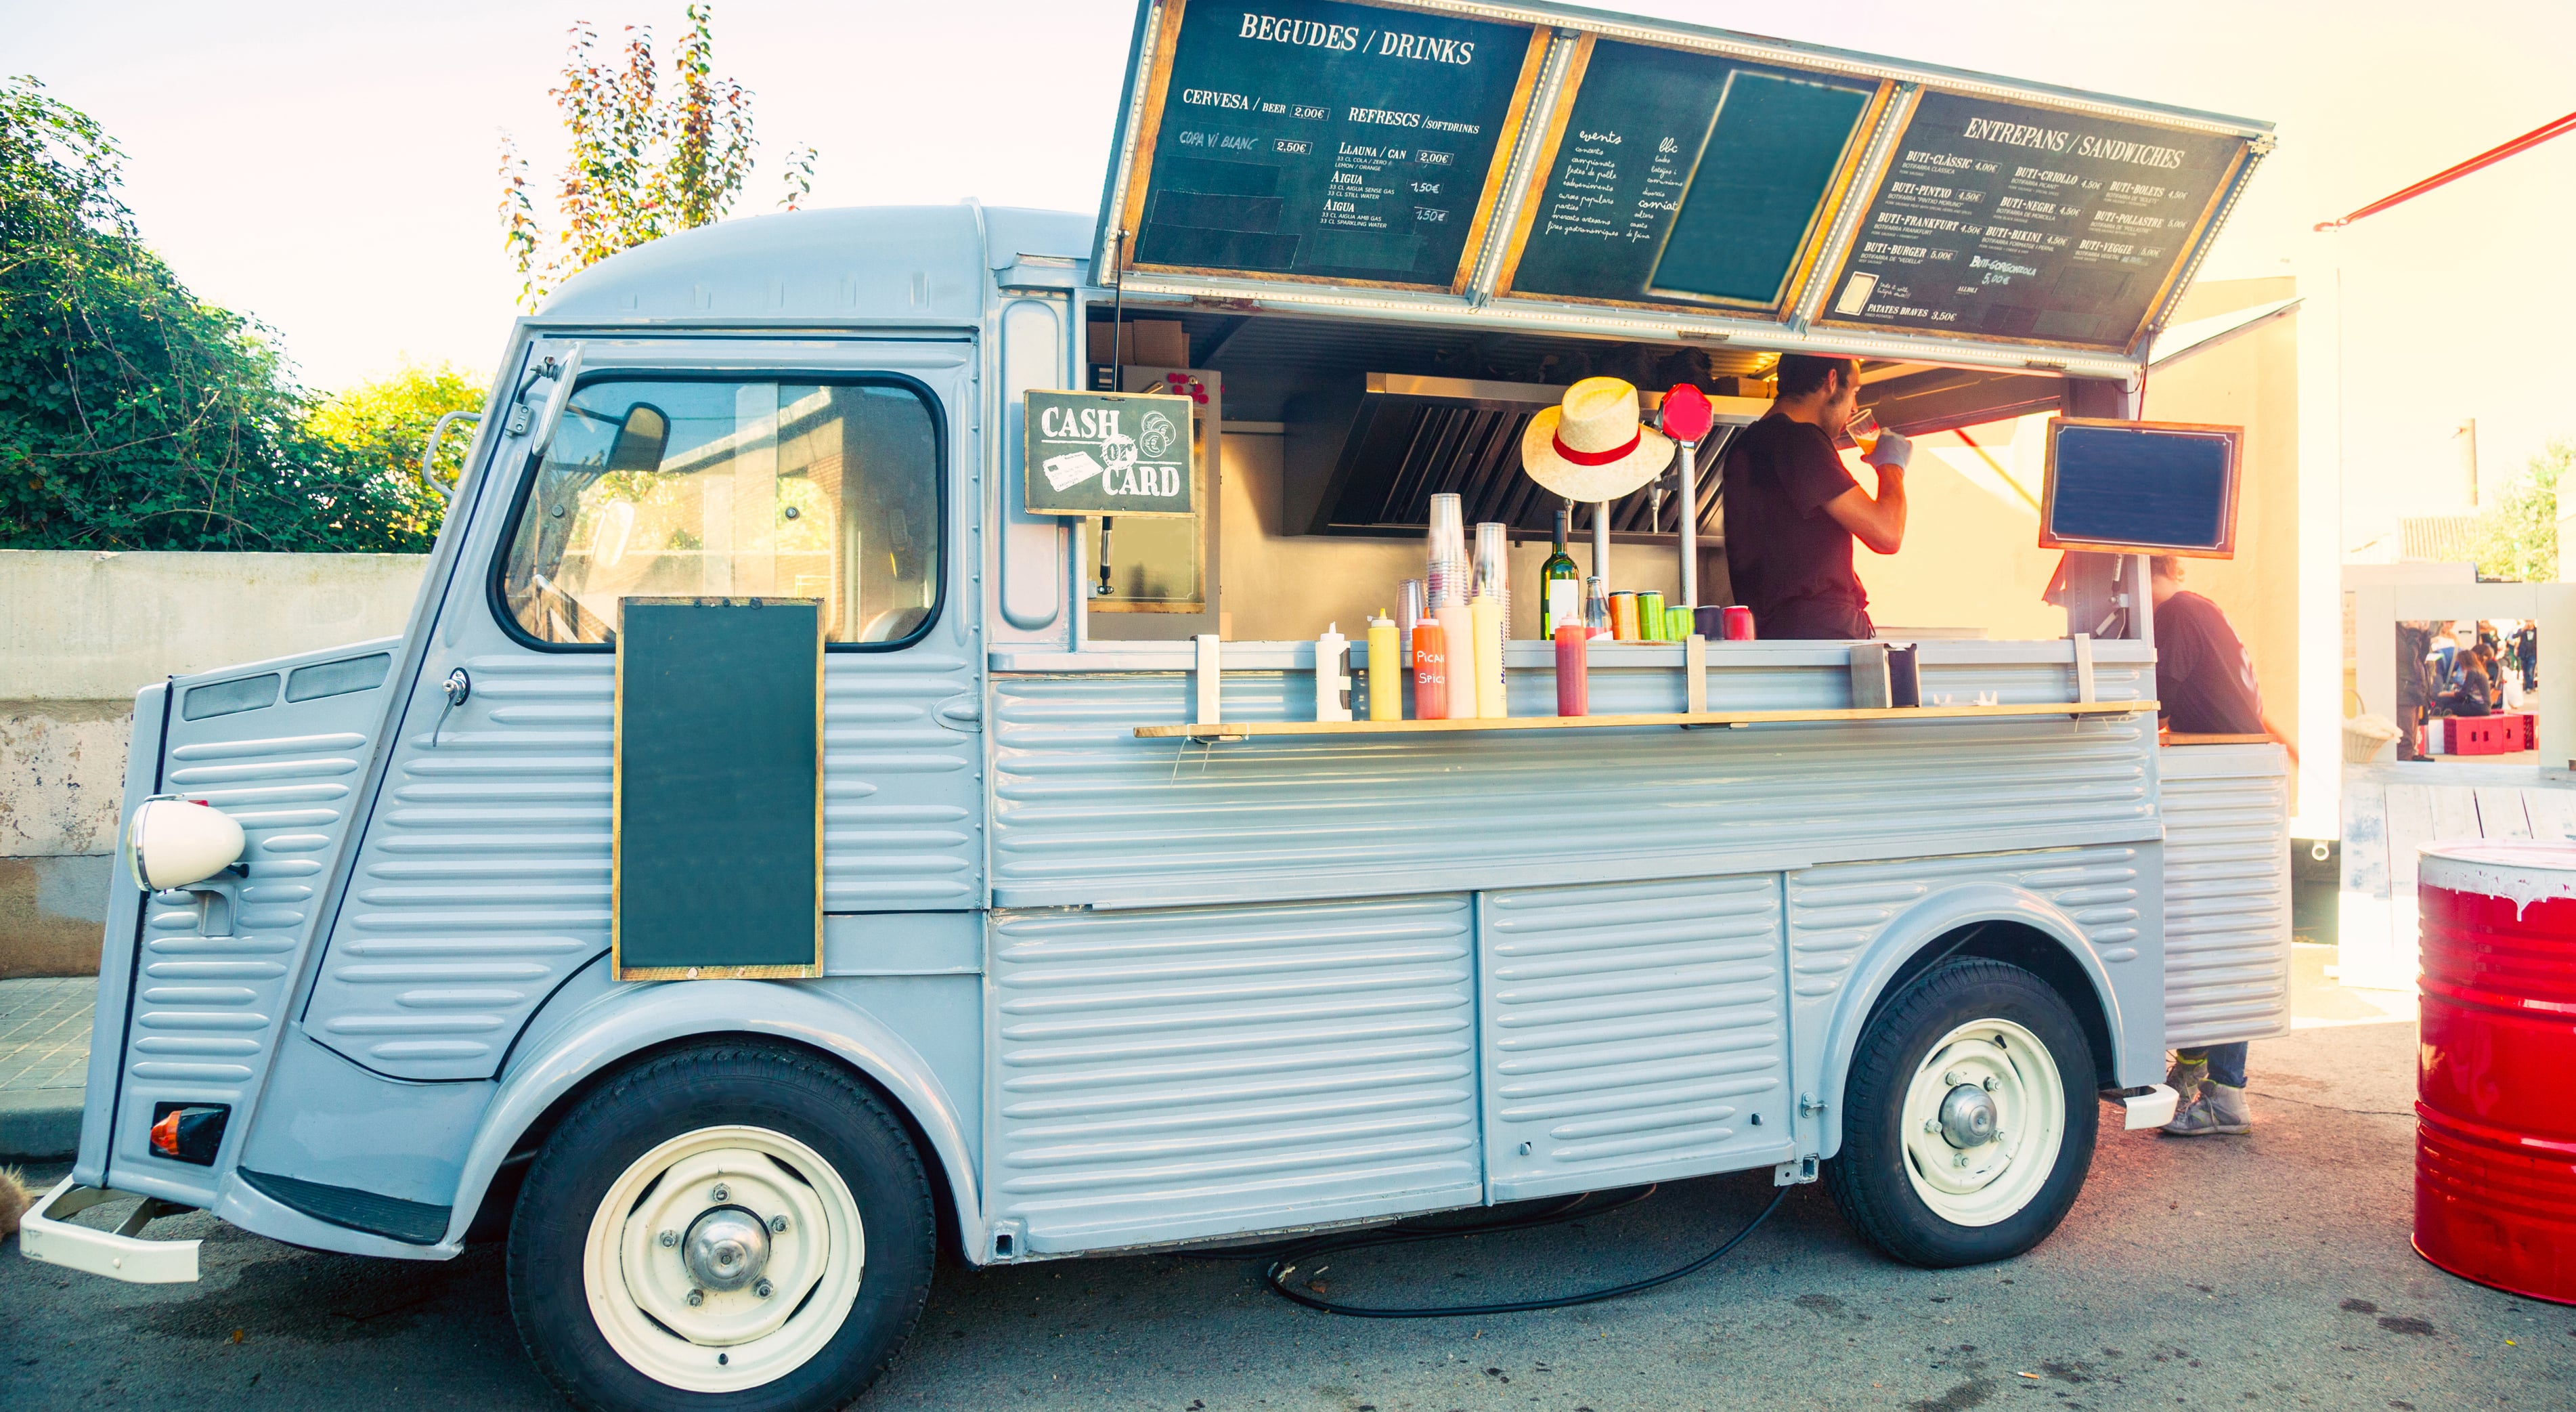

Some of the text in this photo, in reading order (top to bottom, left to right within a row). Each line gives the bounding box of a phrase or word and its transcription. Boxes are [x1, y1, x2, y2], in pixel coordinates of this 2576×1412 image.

[1239, 13, 1475, 65] BEGUDES / DRINKS
[1183, 89, 1248, 110] CERVESA
[1252, 97, 1261, 111] /
[1262, 103, 1286, 114] BEER
[1349, 107, 1420, 127] REFRESCS
[1179, 131, 1204, 146] COPA
[1579, 131, 1622, 144] events
[1963, 117, 2185, 169] ENTREPANS / SANDWICHES
[1380, 146, 1387, 157] /
[1388, 149, 1407, 160] CAN
[2015, 167, 2078, 186] BUTI-CRIOLLO
[1892, 181, 1952, 198] BUTI-PINTXO
[2110, 181, 2165, 198] BUTI-BOLETS
[2000, 196, 2056, 213] BUTI-NEGRE
[1877, 212, 1960, 232] BUTI-FRANKFURT
[2094, 210, 2164, 228] BUTI-POLLASTRE
[1985, 226, 2043, 242] BUTI-BIKINI
[1864, 241, 1927, 258] BUTI-BURGER
[2079, 239, 2134, 255] BUTI-VEGGIE
[1867, 303, 1899, 315] PATATES
[1900, 307, 1928, 318] BRAVES
[1041, 406, 1120, 439] CASH
[1102, 466, 1180, 496] CARD
